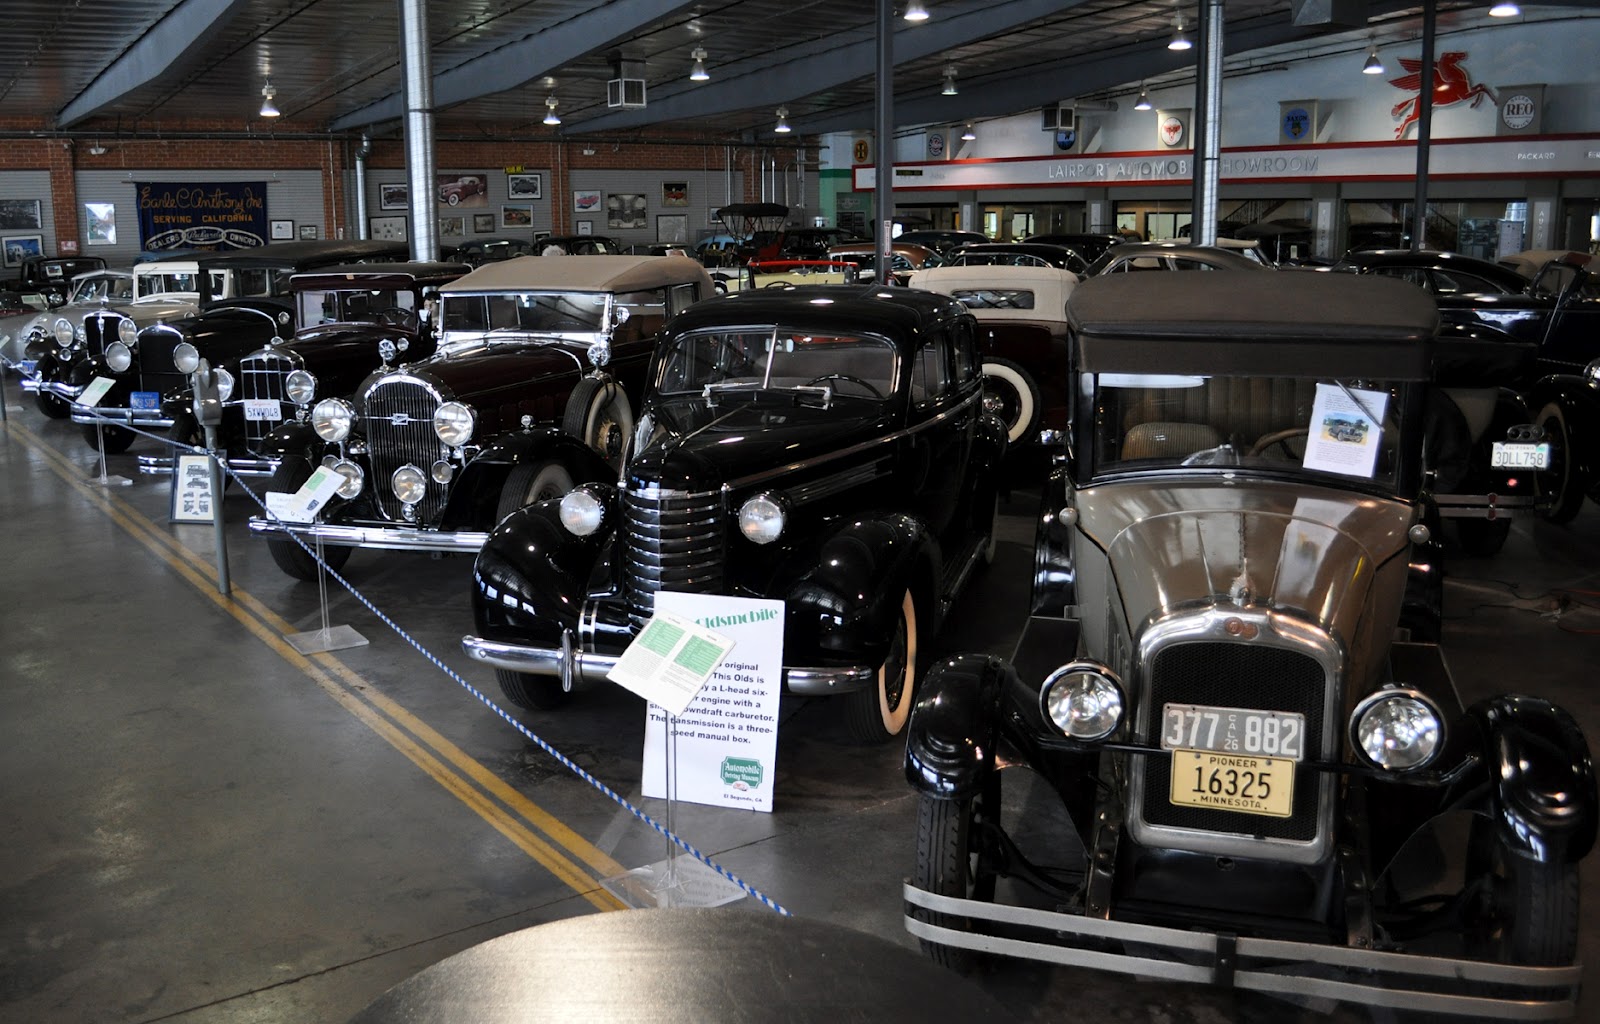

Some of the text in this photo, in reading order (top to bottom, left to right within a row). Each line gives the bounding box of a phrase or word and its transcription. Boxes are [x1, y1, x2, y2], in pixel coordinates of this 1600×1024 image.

[1506, 103, 1533, 115] REO
[1517, 152, 1555, 160] PACKARD
[1048, 162, 1110, 178] LAIRPORT
[1219, 155, 1319, 173] HOWROOM
[140, 186, 177, 209] Earle
[190, 188, 245, 214] Anthony
[153, 214, 253, 223] SERVING CALIFORNIA
[148, 233, 180, 251] DEALERS
[229, 233, 257, 246] OWNERS
[1495, 451, 1544, 466] 3DLL758
[725, 662, 758, 671] original
[713, 672, 731, 680] This
[734, 674, 754, 683] Olds
[720, 684, 749, 694] L-head
[752, 688, 768, 696] six-
[701, 697, 730, 705] engine
[733, 699, 753, 708] with
[684, 706, 774, 722] owndraft carburetor.
[728, 722, 735, 730] is
[746, 724, 773, 733] three-
[1166, 709, 1299, 756] 377 882
[697, 732, 730, 742] manual
[732, 734, 751, 744] box.
[1224, 738, 1239, 750] 26
[1209, 756, 1258, 768] PIONEER
[725, 762, 760, 775] Automobile
[1192, 766, 1271, 800] 16325
[1200, 795, 1262, 809] MINNESOTA
